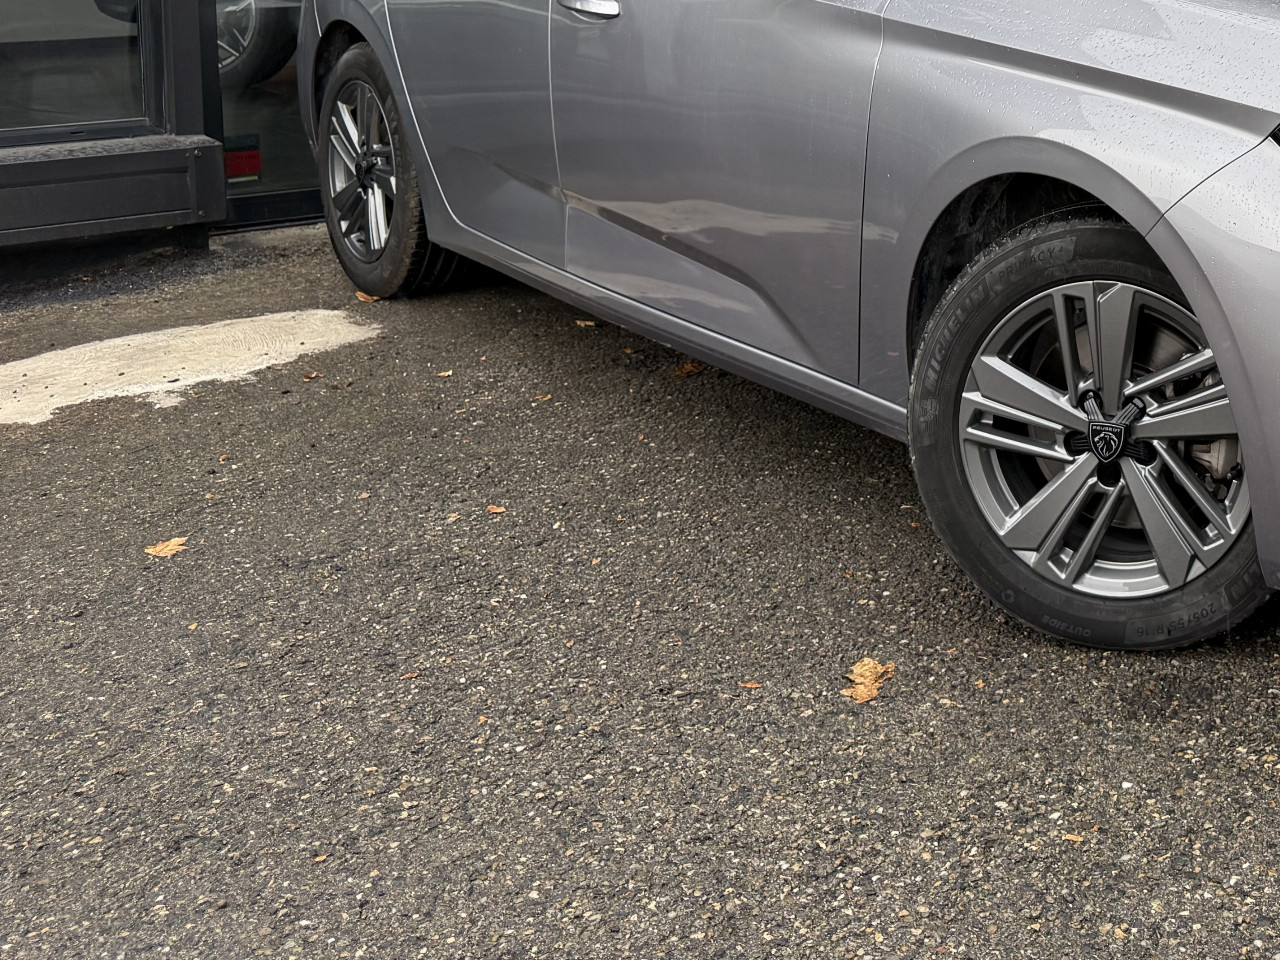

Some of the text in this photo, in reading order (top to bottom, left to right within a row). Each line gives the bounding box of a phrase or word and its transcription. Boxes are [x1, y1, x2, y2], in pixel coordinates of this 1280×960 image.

[998, 245, 1056, 281] PRIMACY
[923, 283, 990, 391] MICHELIN
[1092, 425, 1121, 433] PEUGEOT
